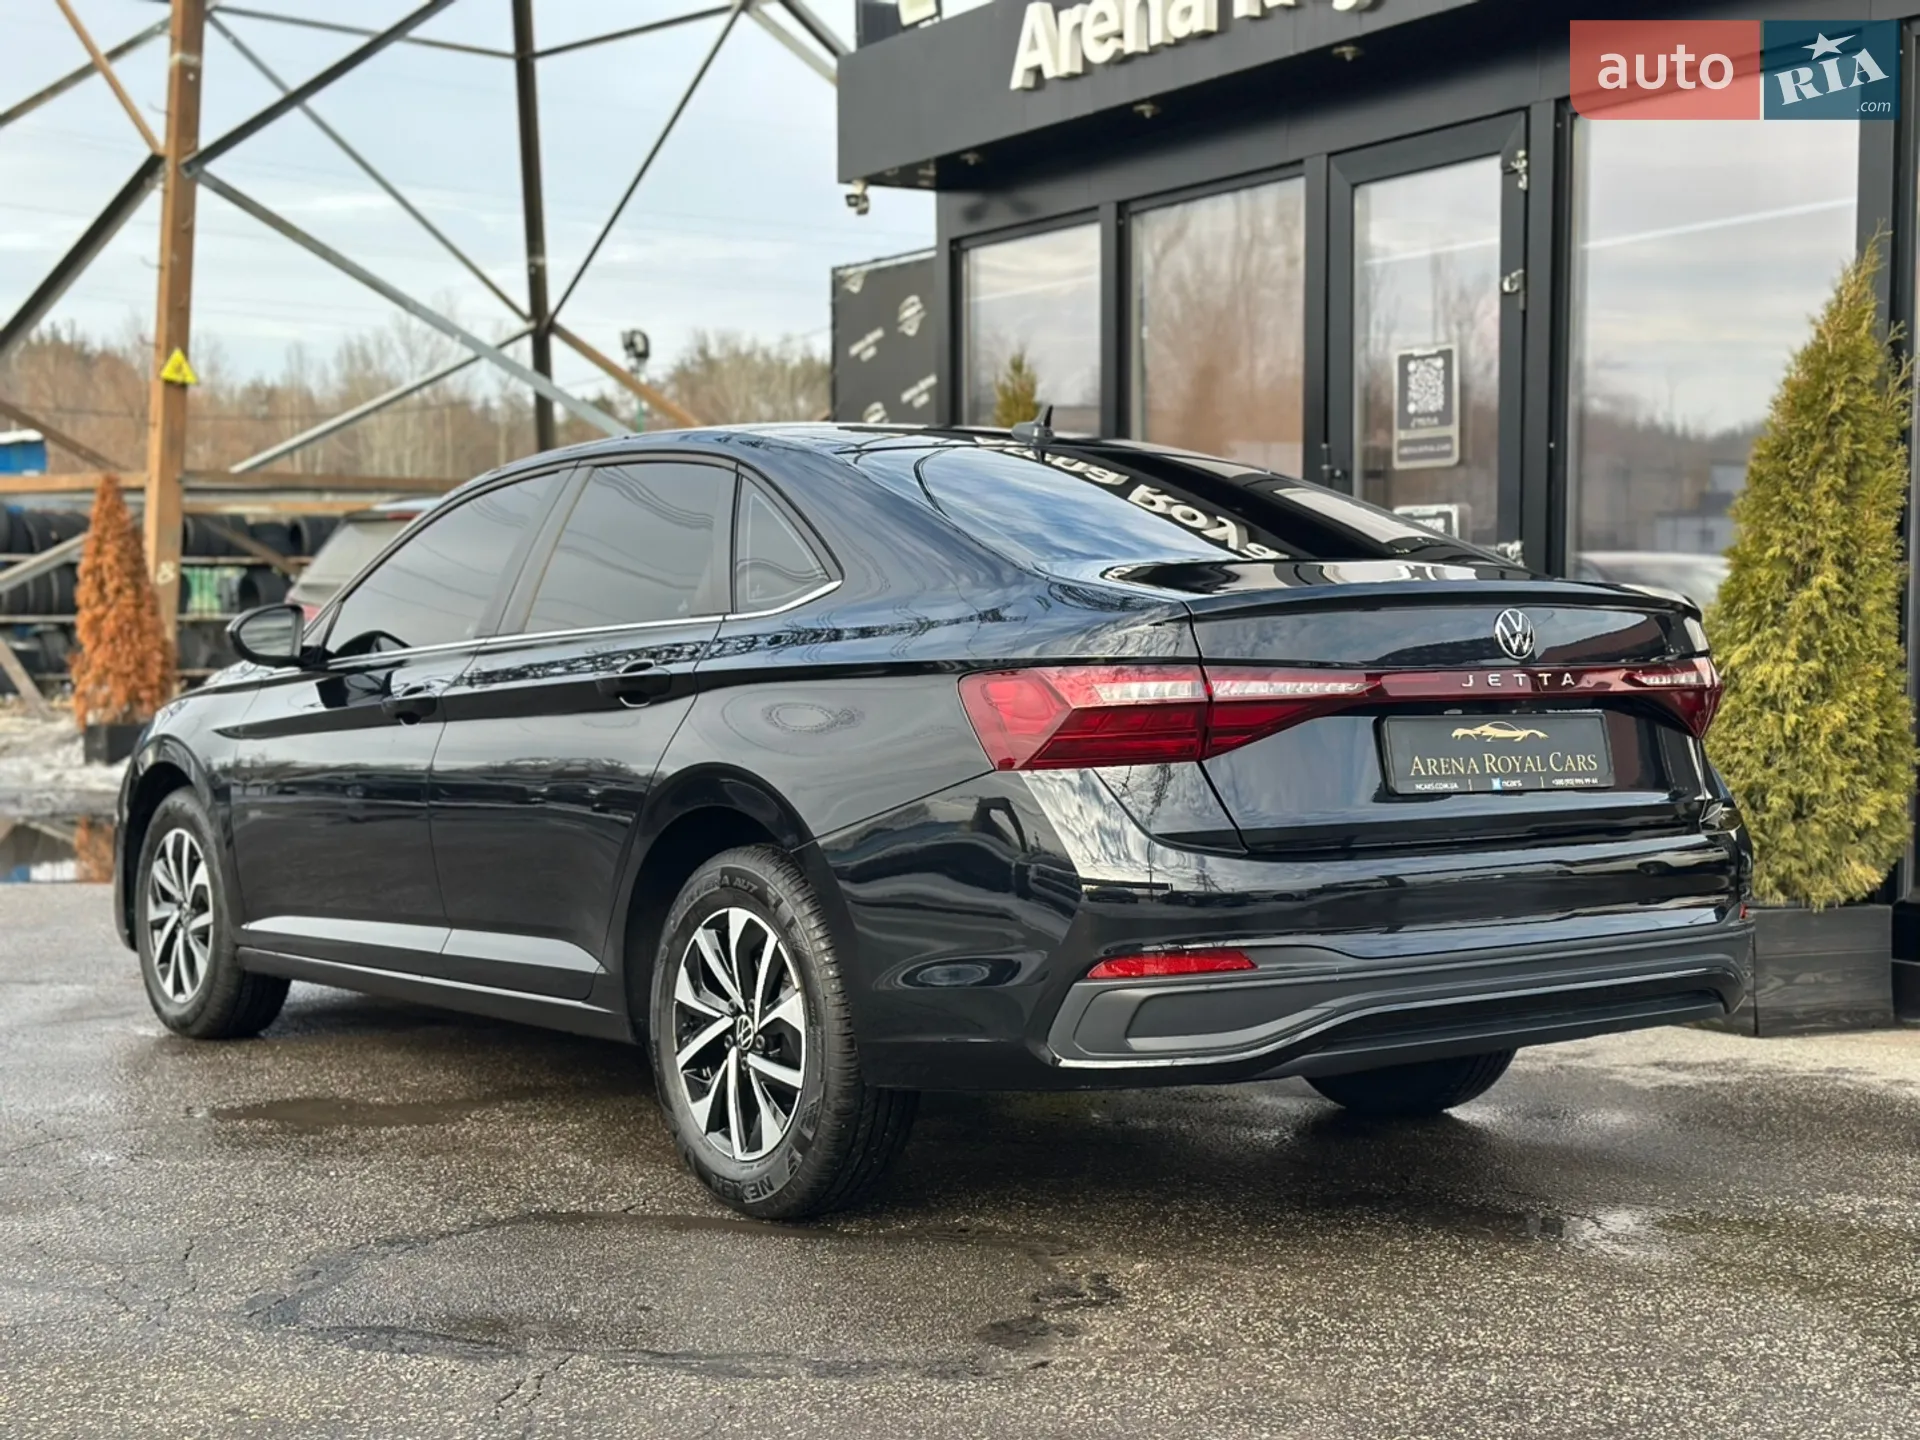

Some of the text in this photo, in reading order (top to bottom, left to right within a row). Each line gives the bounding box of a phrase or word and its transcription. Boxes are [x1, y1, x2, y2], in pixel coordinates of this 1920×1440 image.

[1010, 0, 1218, 90] Arena
[1462, 672, 1575, 688] JETTA
[1409, 751, 1598, 776] ARENA ROYAL CARS
